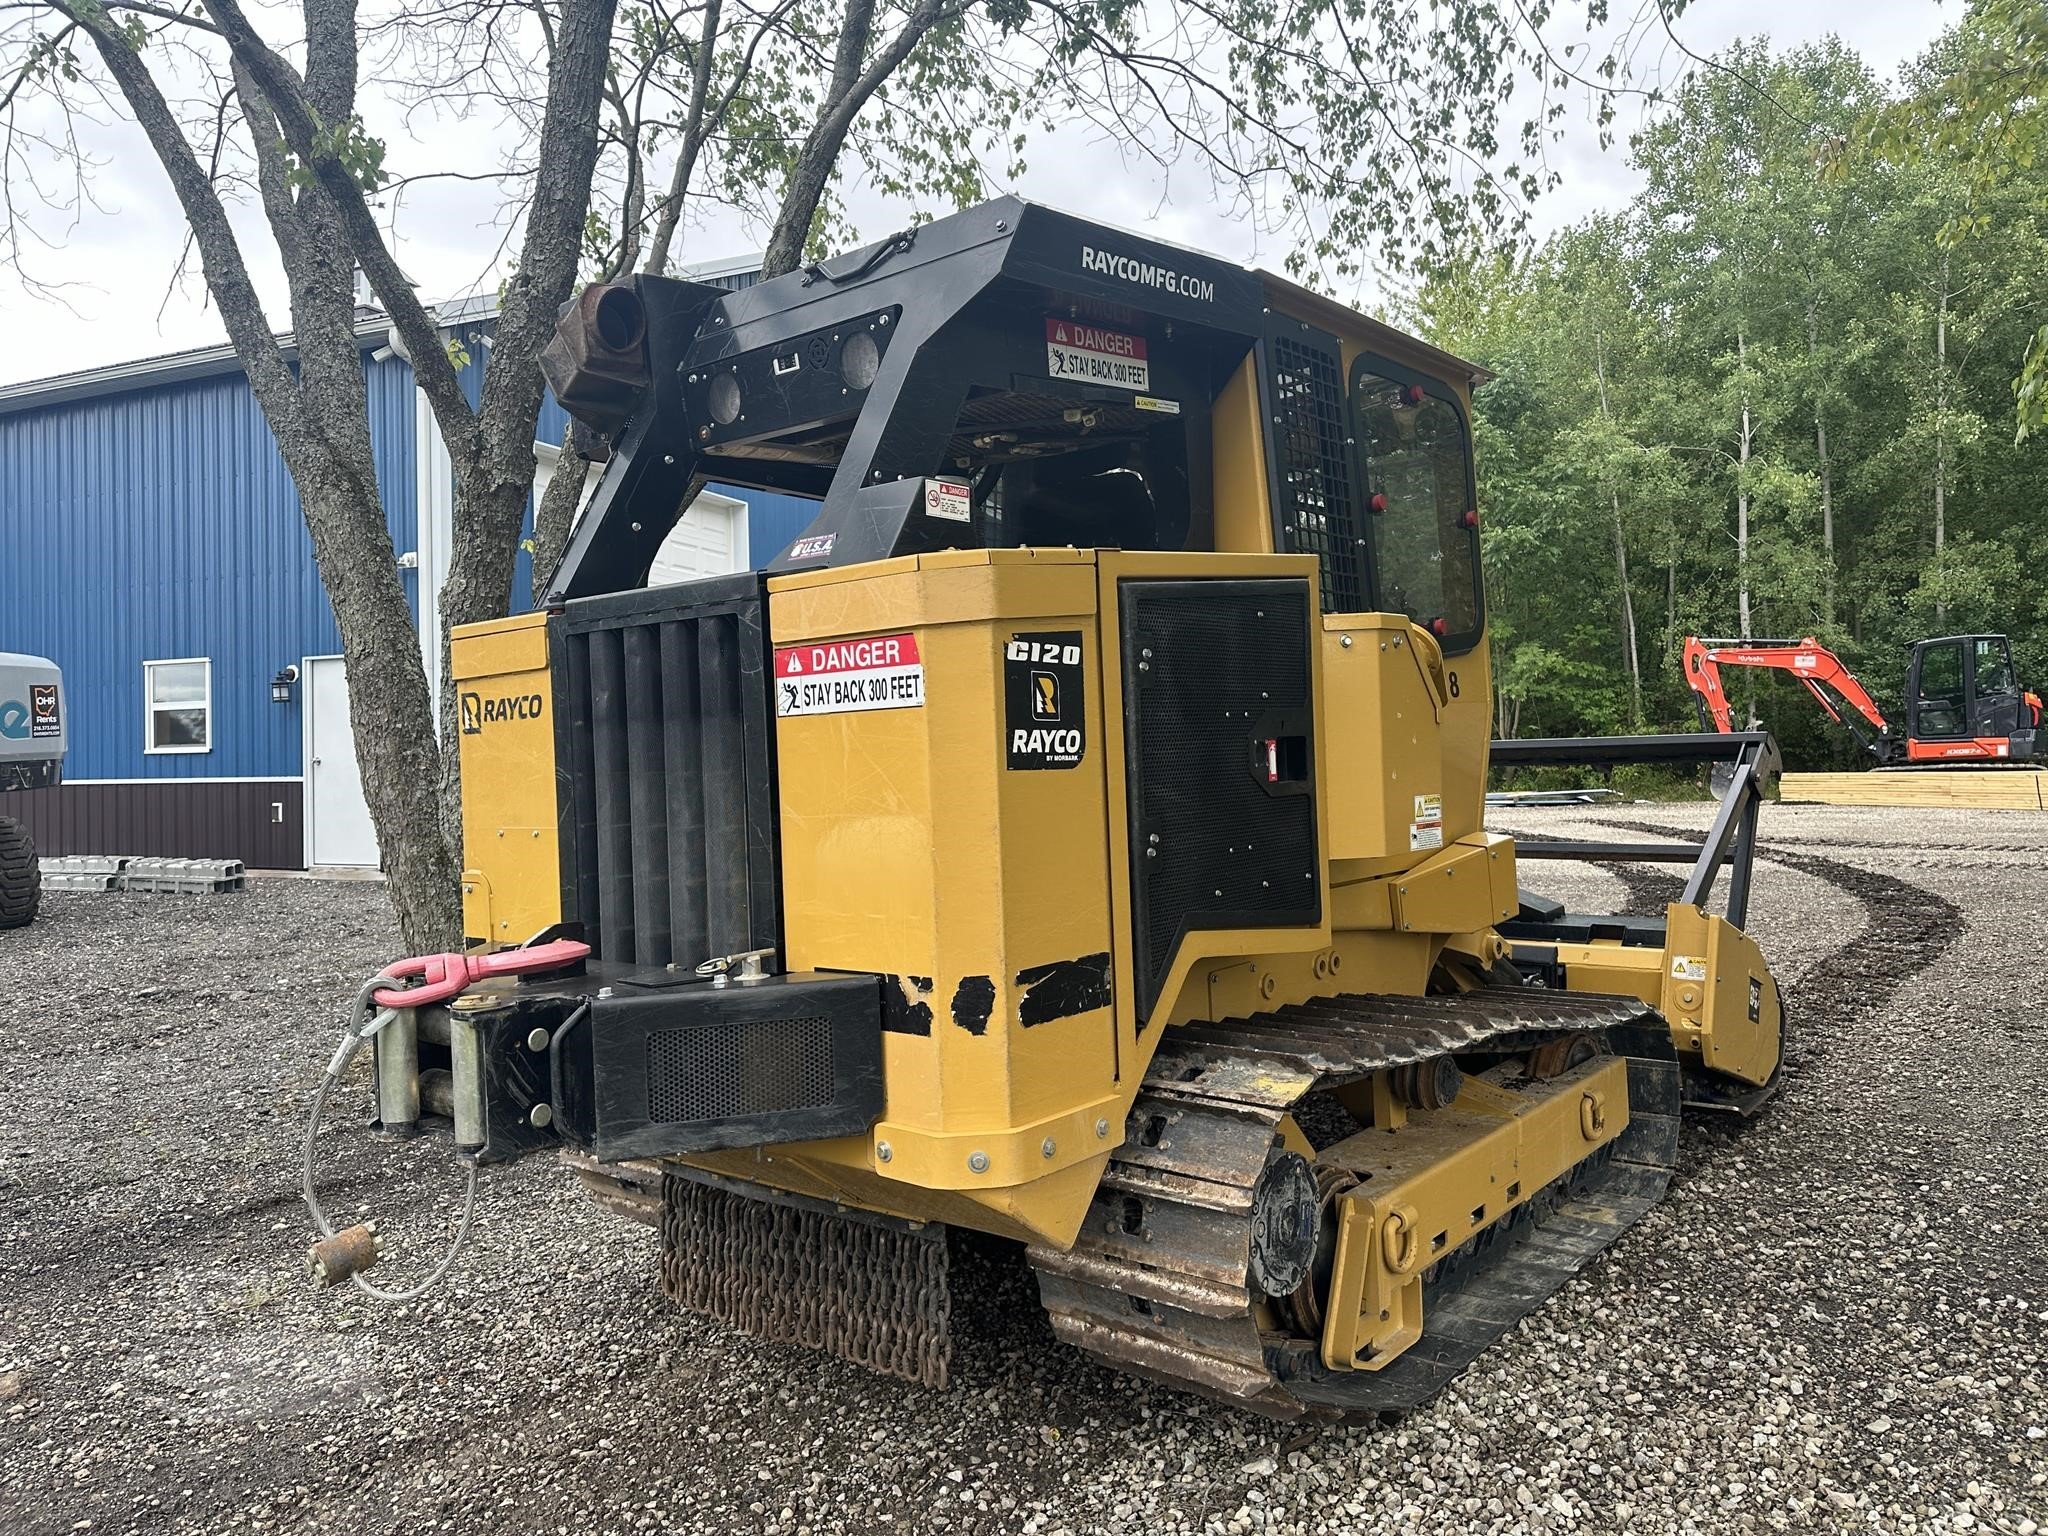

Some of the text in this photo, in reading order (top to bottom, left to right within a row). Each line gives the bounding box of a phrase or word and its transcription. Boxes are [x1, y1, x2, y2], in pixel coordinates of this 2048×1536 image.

[1081, 246, 1214, 303] RAYCOMFG.COM
[1074, 326, 1134, 356] DANGER
[1068, 354, 1146, 385] STAY BACK 300 FEET
[948, 486, 968, 497] DANGER
[811, 639, 900, 672] DANGER
[1006, 641, 1081, 665] C120
[803, 674, 920, 706] STAY BACK 300 FEET
[1448, 671, 1460, 698] 8
[36, 696, 56, 706] OHR
[483, 694, 542, 722] RAYCO
[1012, 729, 1082, 753] RAYCO
